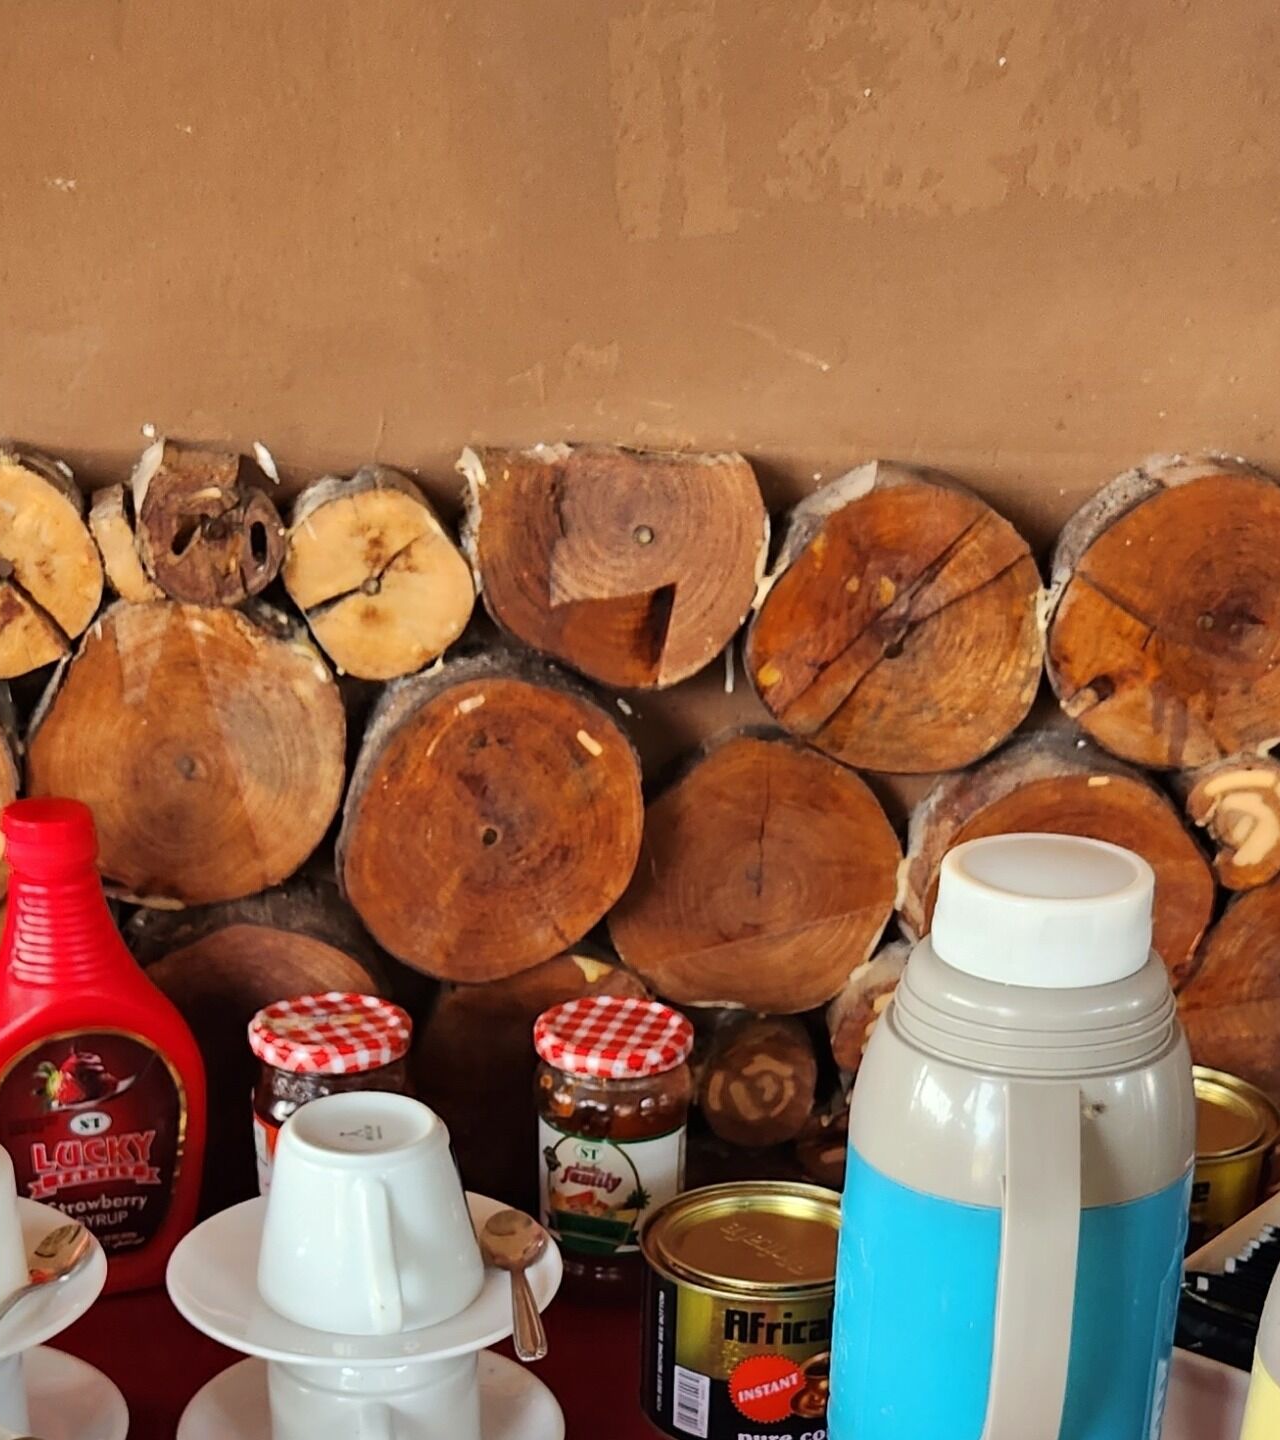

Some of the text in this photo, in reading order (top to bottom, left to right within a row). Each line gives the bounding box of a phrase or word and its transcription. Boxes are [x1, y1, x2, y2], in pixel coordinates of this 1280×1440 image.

[31, 1130, 156, 1174] LUCKY
[724, 1309, 830, 1345] Africa
[738, 1372, 799, 1403] INSTANT
